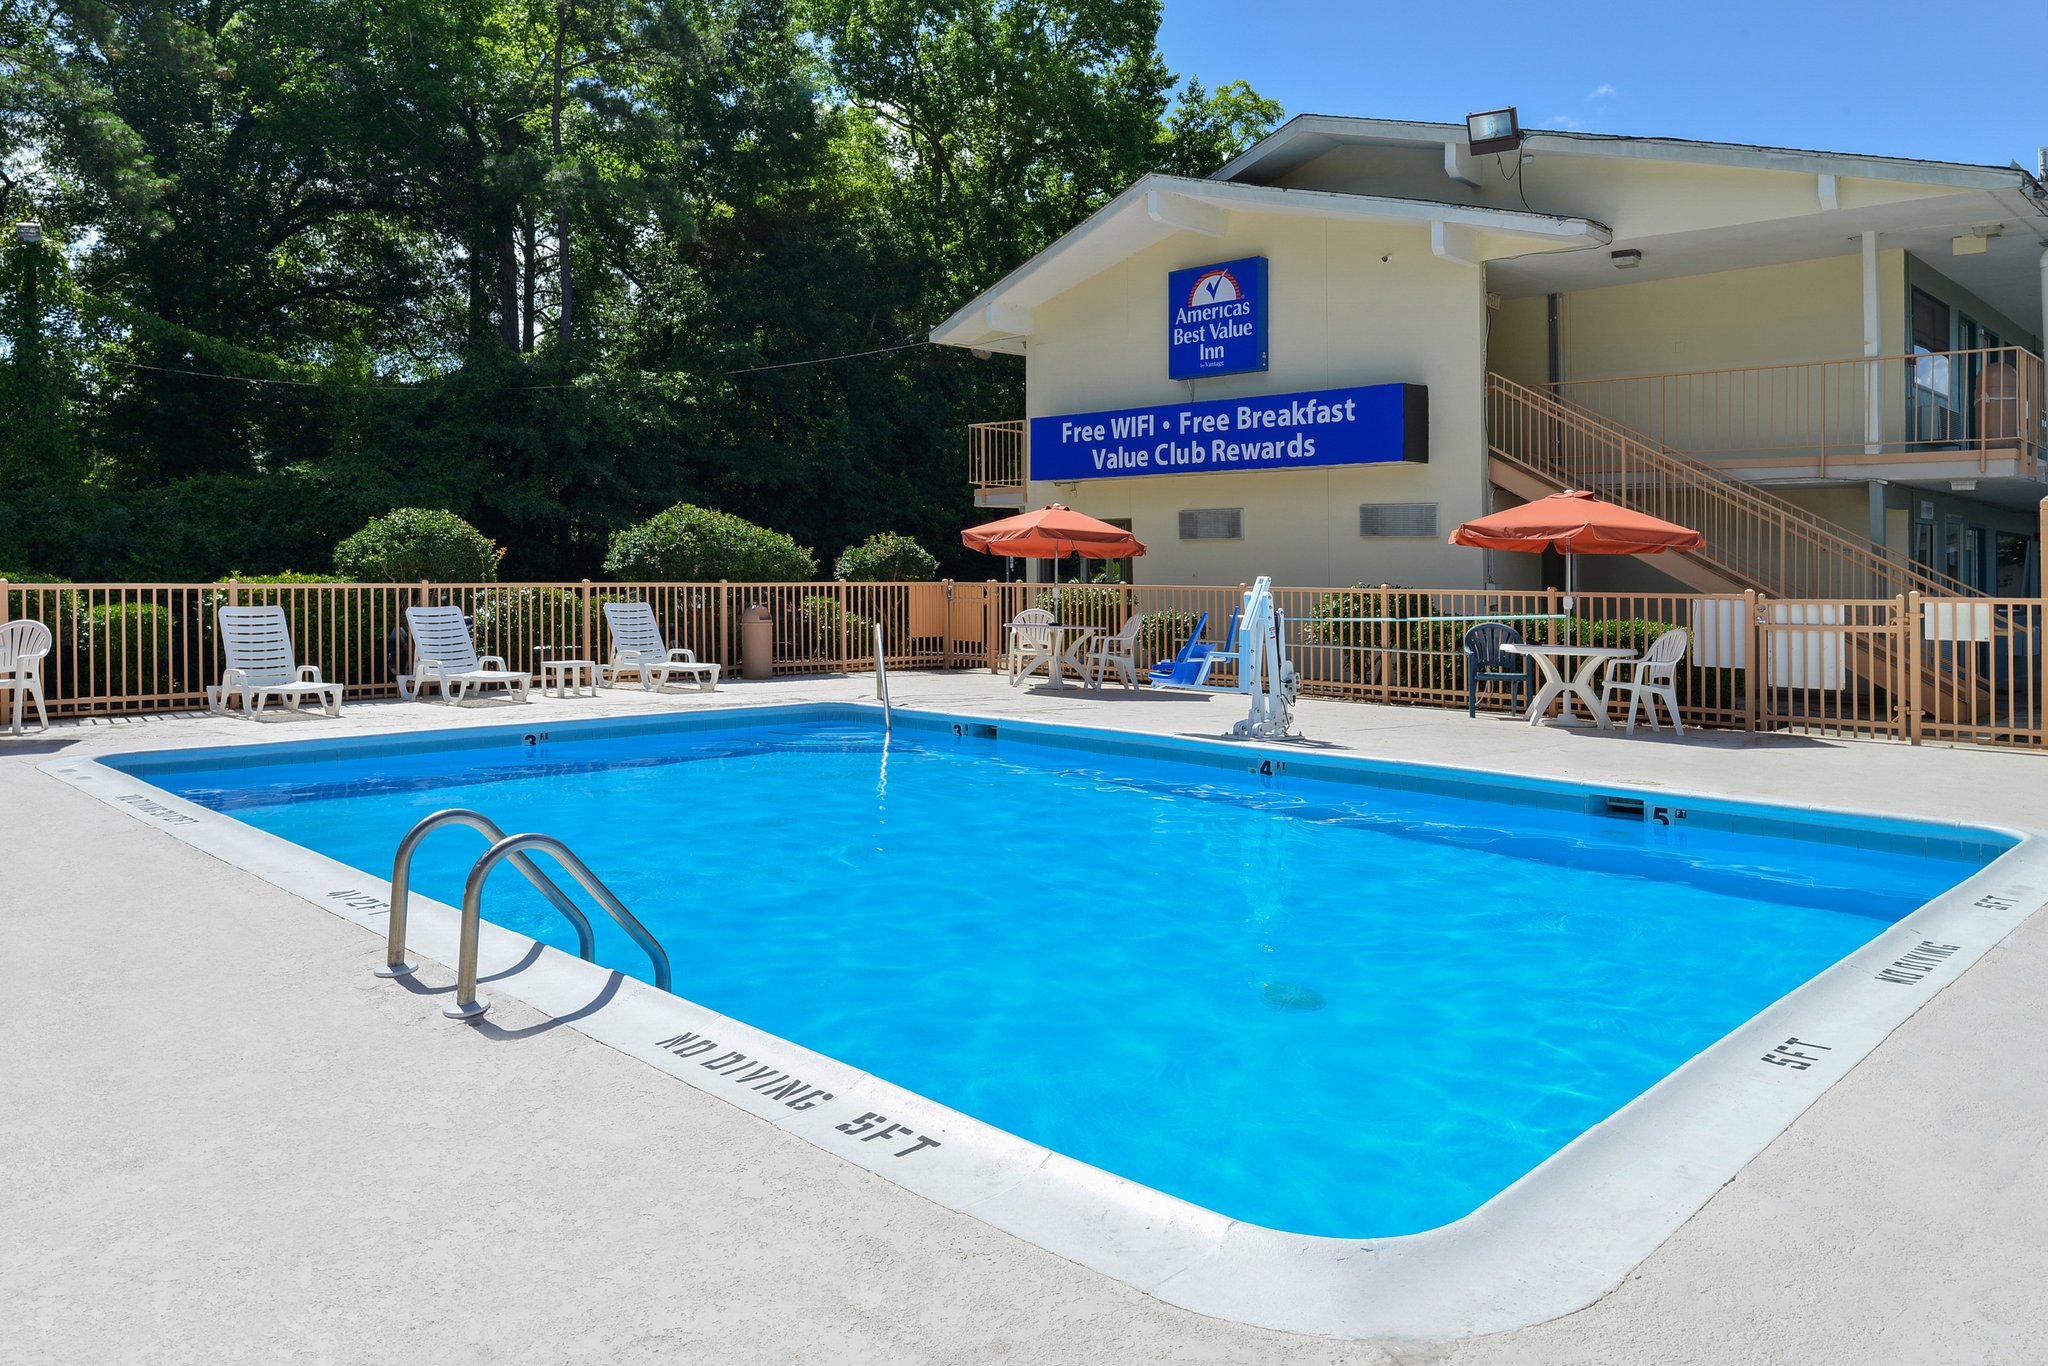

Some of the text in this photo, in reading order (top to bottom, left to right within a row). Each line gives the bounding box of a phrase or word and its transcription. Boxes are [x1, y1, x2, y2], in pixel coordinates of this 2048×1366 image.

[1175, 301, 1251, 325] Americas
[1173, 319, 1253, 346] Best Value
[1200, 343, 1225, 361] Inn
[1062, 398, 1356, 444] Free WIFI Free Breakfast
[1092, 432, 1316, 470] Value Club Rewards
[1260, 760, 1273, 776] 4
[1652, 807, 1669, 825] 5
[1973, 894, 2020, 911] 5FT
[1761, 1037, 1832, 1070] 5FT
[654, 1031, 718, 1058] NO
[699, 1051, 835, 1111] DIVING
